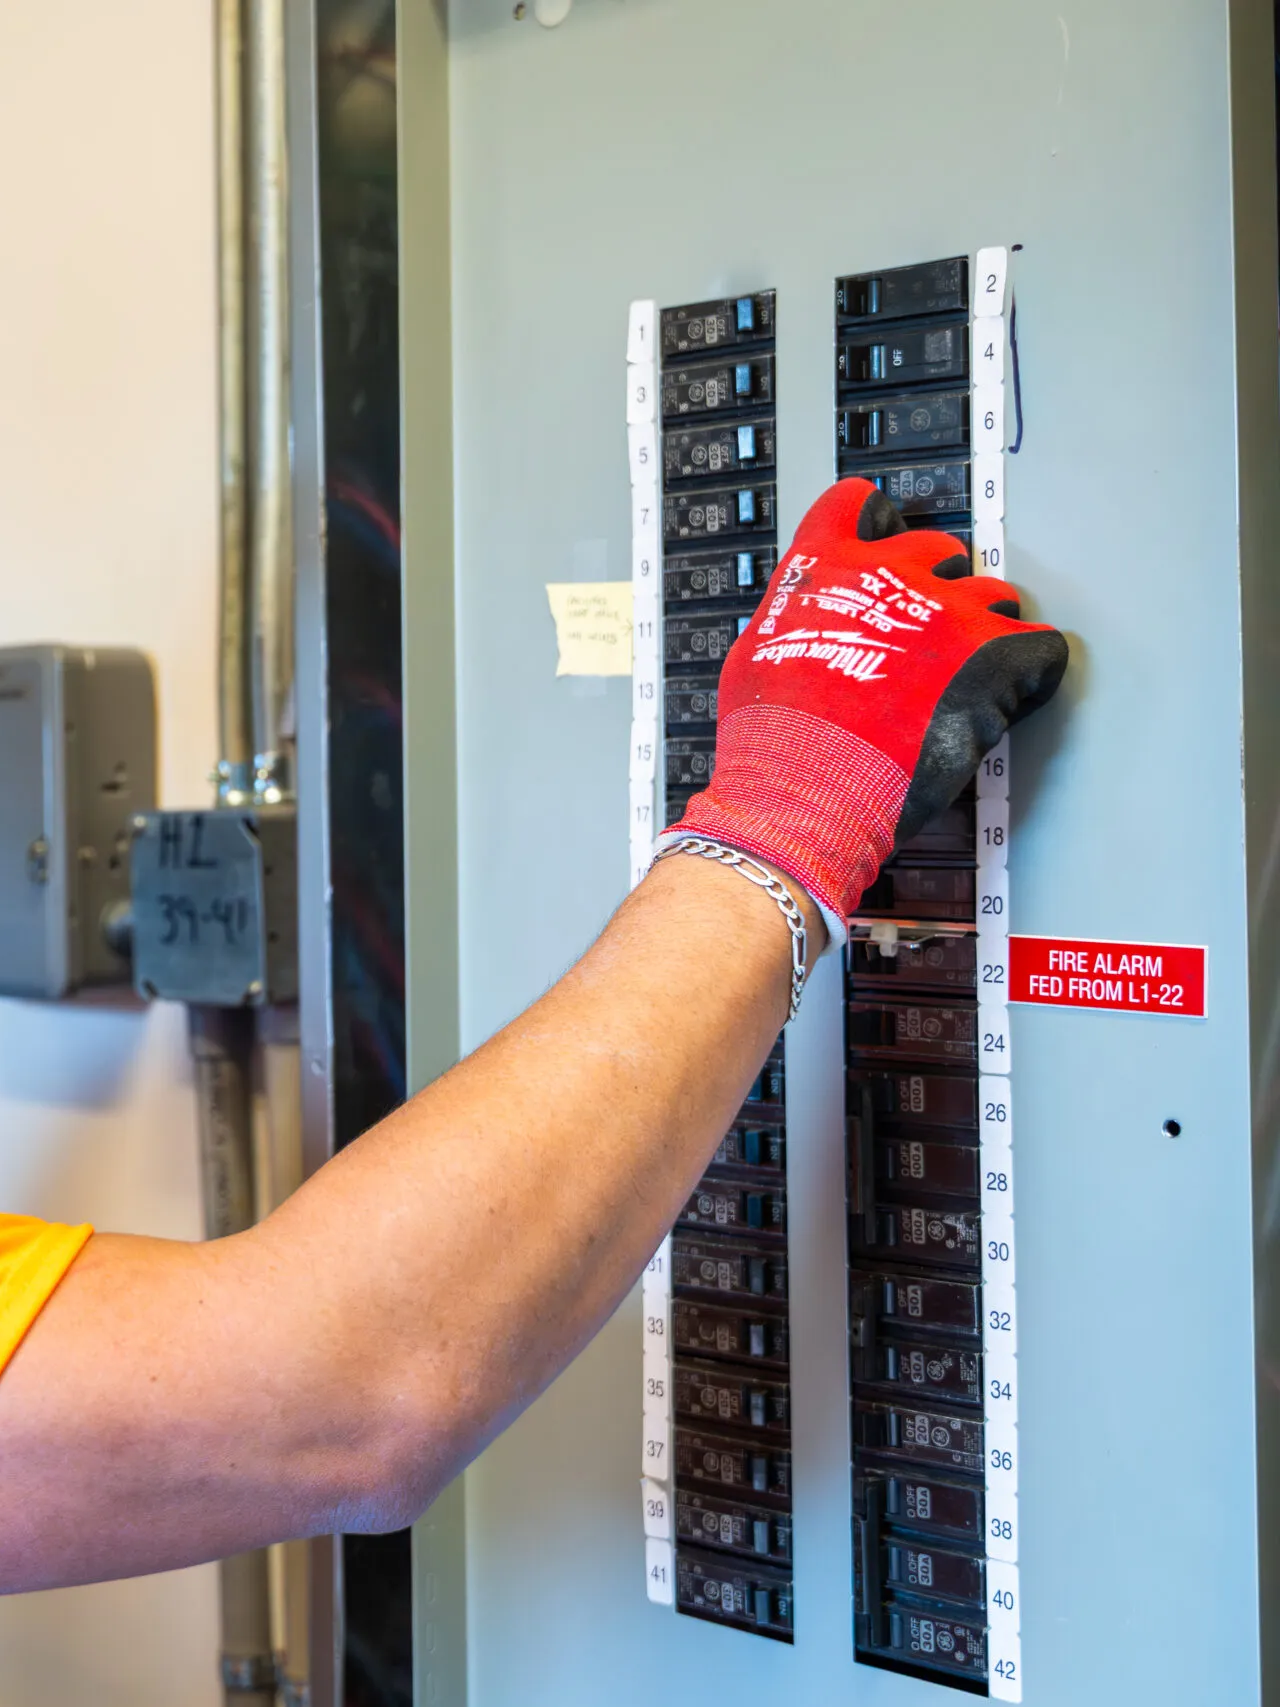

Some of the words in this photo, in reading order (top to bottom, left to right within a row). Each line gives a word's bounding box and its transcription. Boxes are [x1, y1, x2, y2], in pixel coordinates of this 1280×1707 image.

[986, 274, 996, 292] 2
[639, 324, 645, 341] 1
[893, 349, 902, 366] OFF
[984, 342, 994, 360] 4
[636, 386, 647, 404] 3
[888, 412, 898, 434] OFF
[984, 411, 994, 430] 6
[638, 447, 648, 464] 5
[890, 476, 899, 496] OFF
[902, 472, 912, 496] 20A
[985, 480, 995, 498] 8
[639, 507, 649, 524] 7
[980, 548, 1000, 567] 10
[640, 560, 650, 577] 9
[859, 572, 887, 596] XL
[800, 596, 810, 606] 1
[817, 599, 858, 618] LEVEL
[638, 621, 652, 638] 11
[861, 609, 892, 632] CUT
[751, 642, 888, 682] Milwaukee
[638, 682, 654, 700] 13
[636, 744, 652, 761] 15
[983, 758, 1004, 777] 16
[636, 806, 650, 822] 17
[983, 827, 1004, 845] 18
[981, 895, 1003, 915] 20
[982, 964, 1004, 983] 22
[1048, 950, 1088, 973] FIRE
[1093, 953, 1163, 978] ALARM
[1029, 974, 1063, 997] FED
[1068, 977, 1122, 1001] FROM
[1128, 981, 1184, 1007] L1-22
[897, 1012, 906, 1032] OFF
[983, 1033, 1005, 1052] 24
[912, 1078, 922, 1111] 100A
[985, 1102, 1007, 1122] 26
[912, 1144, 922, 1176] 100A
[986, 1172, 1008, 1191] 28
[913, 1211, 923, 1243] 100A
[988, 1241, 1009, 1261] 30
[647, 1317, 664, 1335] 33
[989, 1310, 1011, 1331] 32
[911, 1353, 922, 1381] 30A
[647, 1378, 664, 1397] 35
[990, 1380, 1012, 1400] 34
[905, 1418, 915, 1438] OFF
[916, 1417, 928, 1442] 20A
[647, 1440, 664, 1458] 37
[990, 1449, 1012, 1470] 36
[647, 1499, 664, 1518] 39
[918, 1489, 929, 1517] 30A
[990, 1518, 1012, 1540] 38
[650, 1565, 667, 1584] 41
[920, 1556, 931, 1584] 30A
[992, 1589, 1014, 1610] 40
[922, 1622, 933, 1650] 30A
[994, 1659, 1016, 1680] 42
